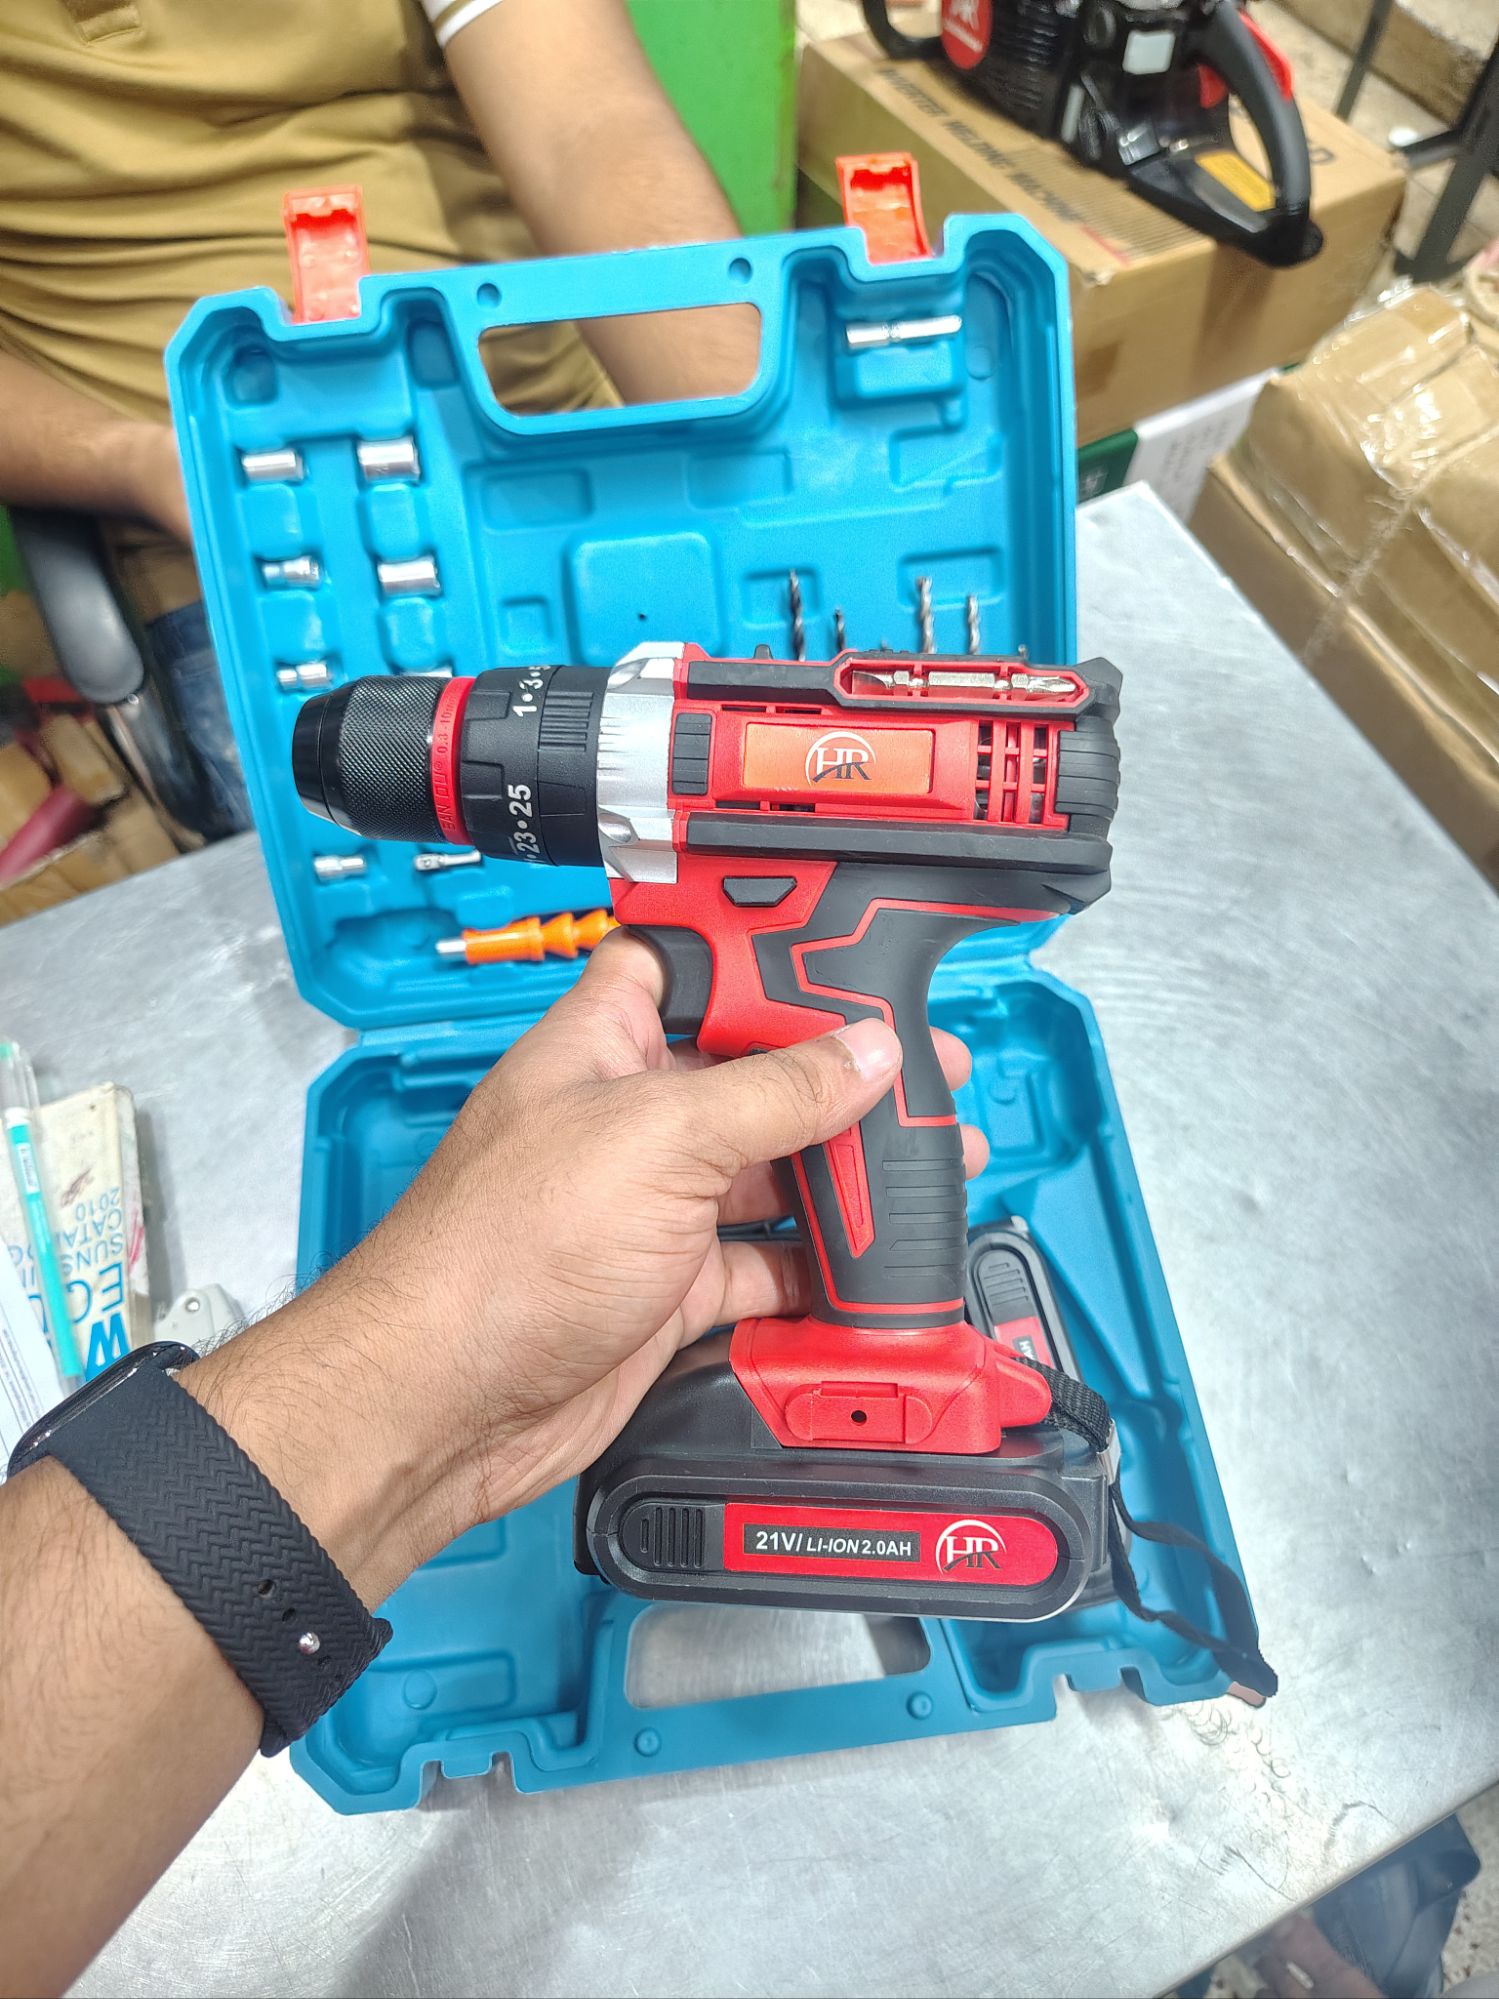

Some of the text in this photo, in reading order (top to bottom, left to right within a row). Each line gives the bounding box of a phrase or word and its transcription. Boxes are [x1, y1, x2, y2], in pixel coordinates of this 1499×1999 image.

[512, 705, 537, 718] 1
[811, 745, 873, 784] HR
[507, 784, 541, 854] 23 25
[75, 1186, 121, 1222] 2010
[755, 1530, 1002, 1572] 21V/ LI-ION 2.0AH HR
